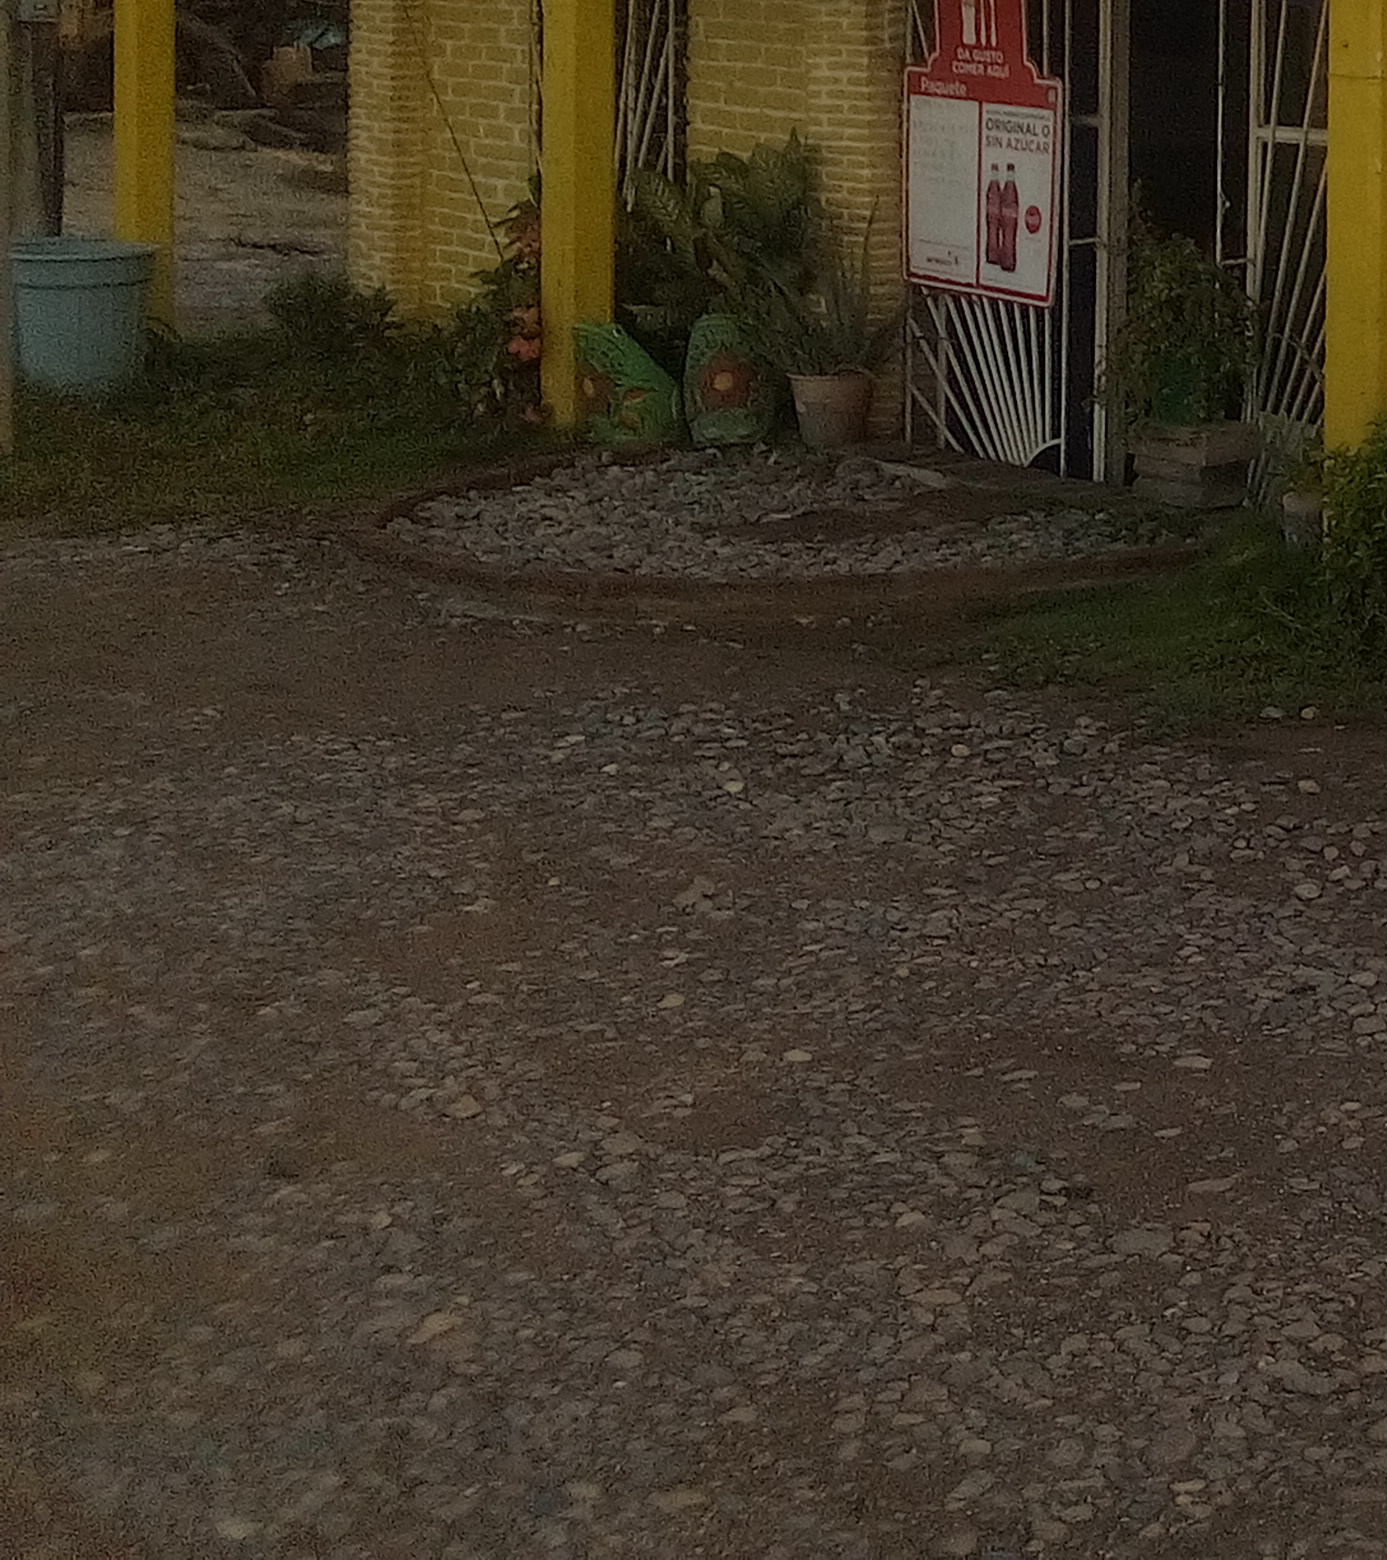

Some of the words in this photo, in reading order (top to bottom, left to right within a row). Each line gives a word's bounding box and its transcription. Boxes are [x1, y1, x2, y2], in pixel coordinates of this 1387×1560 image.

[920, 77, 967, 96] Paquete
[985, 117, 1037, 137] ORIGINAL
[1041, 124, 1051, 138] O
[985, 135, 1003, 149] SIN
